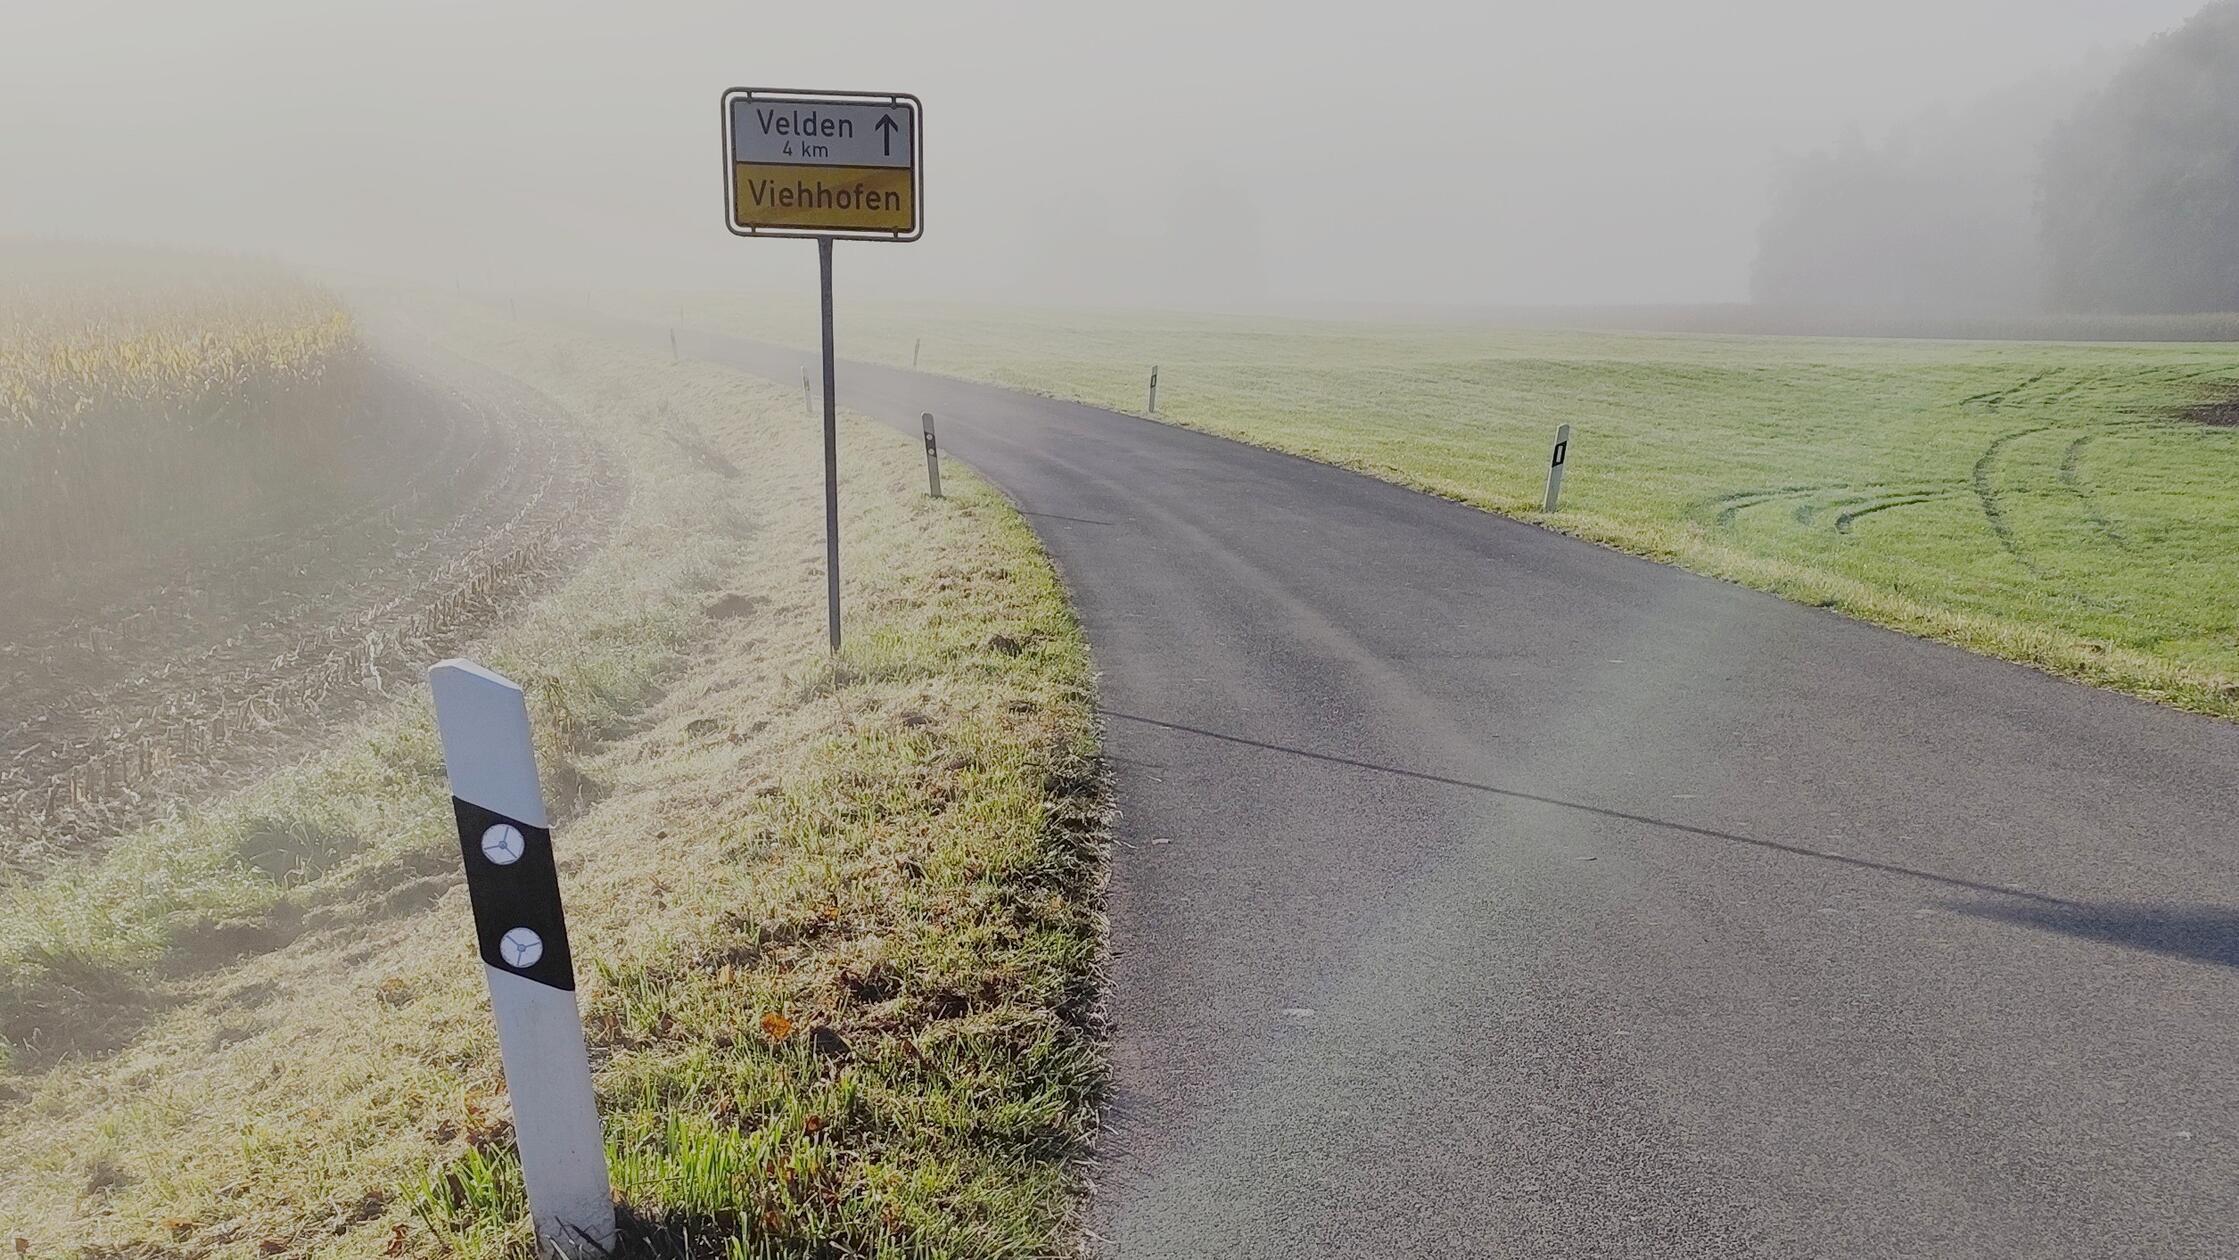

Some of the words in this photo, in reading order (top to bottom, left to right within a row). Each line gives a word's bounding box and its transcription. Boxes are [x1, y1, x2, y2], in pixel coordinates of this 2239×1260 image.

[757, 109, 853, 138] Velden
[782, 140, 793, 156] 4
[801, 141, 829, 157] km
[748, 179, 900, 211] Viehhofen
